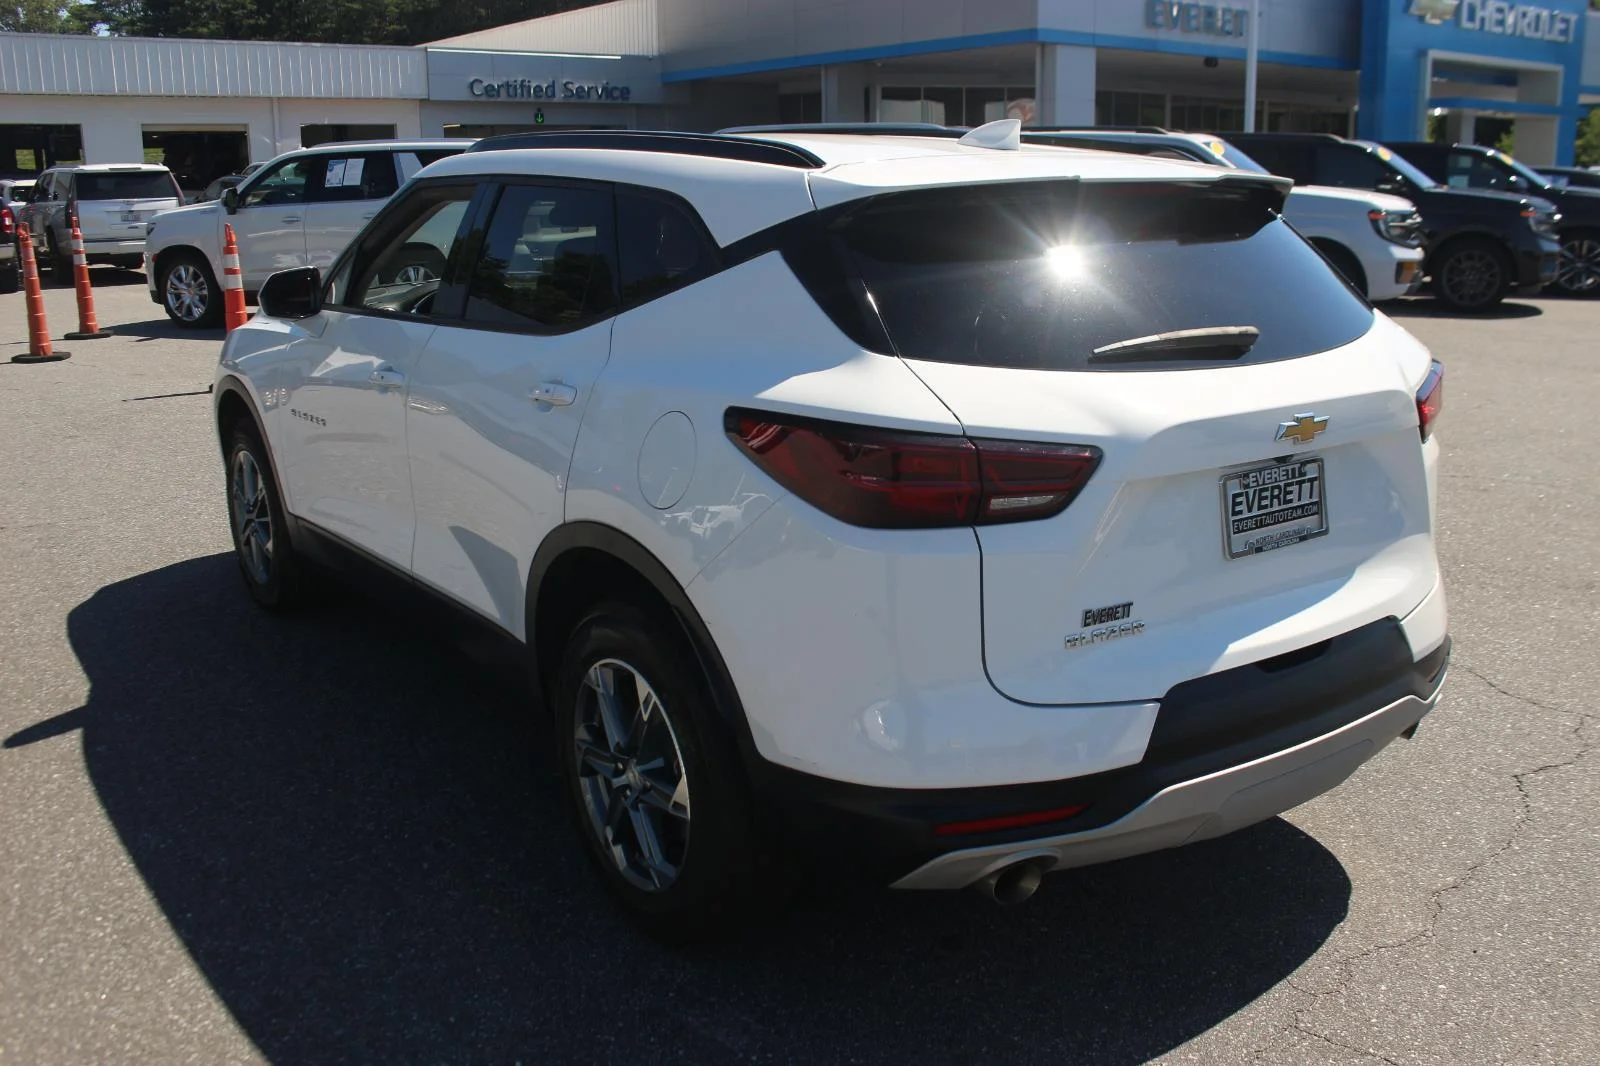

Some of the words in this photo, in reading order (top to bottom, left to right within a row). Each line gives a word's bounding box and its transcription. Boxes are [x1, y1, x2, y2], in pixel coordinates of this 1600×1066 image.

[1460, 0, 1579, 43] CHEVROLET
[469, 78, 556, 98] Certified
[562, 80, 631, 101] Service
[1248, 464, 1300, 487] EVERETT
[1231, 477, 1319, 517] EVERETT
[1233, 503, 1319, 533] EVERETTAUTOTEAM.COM
